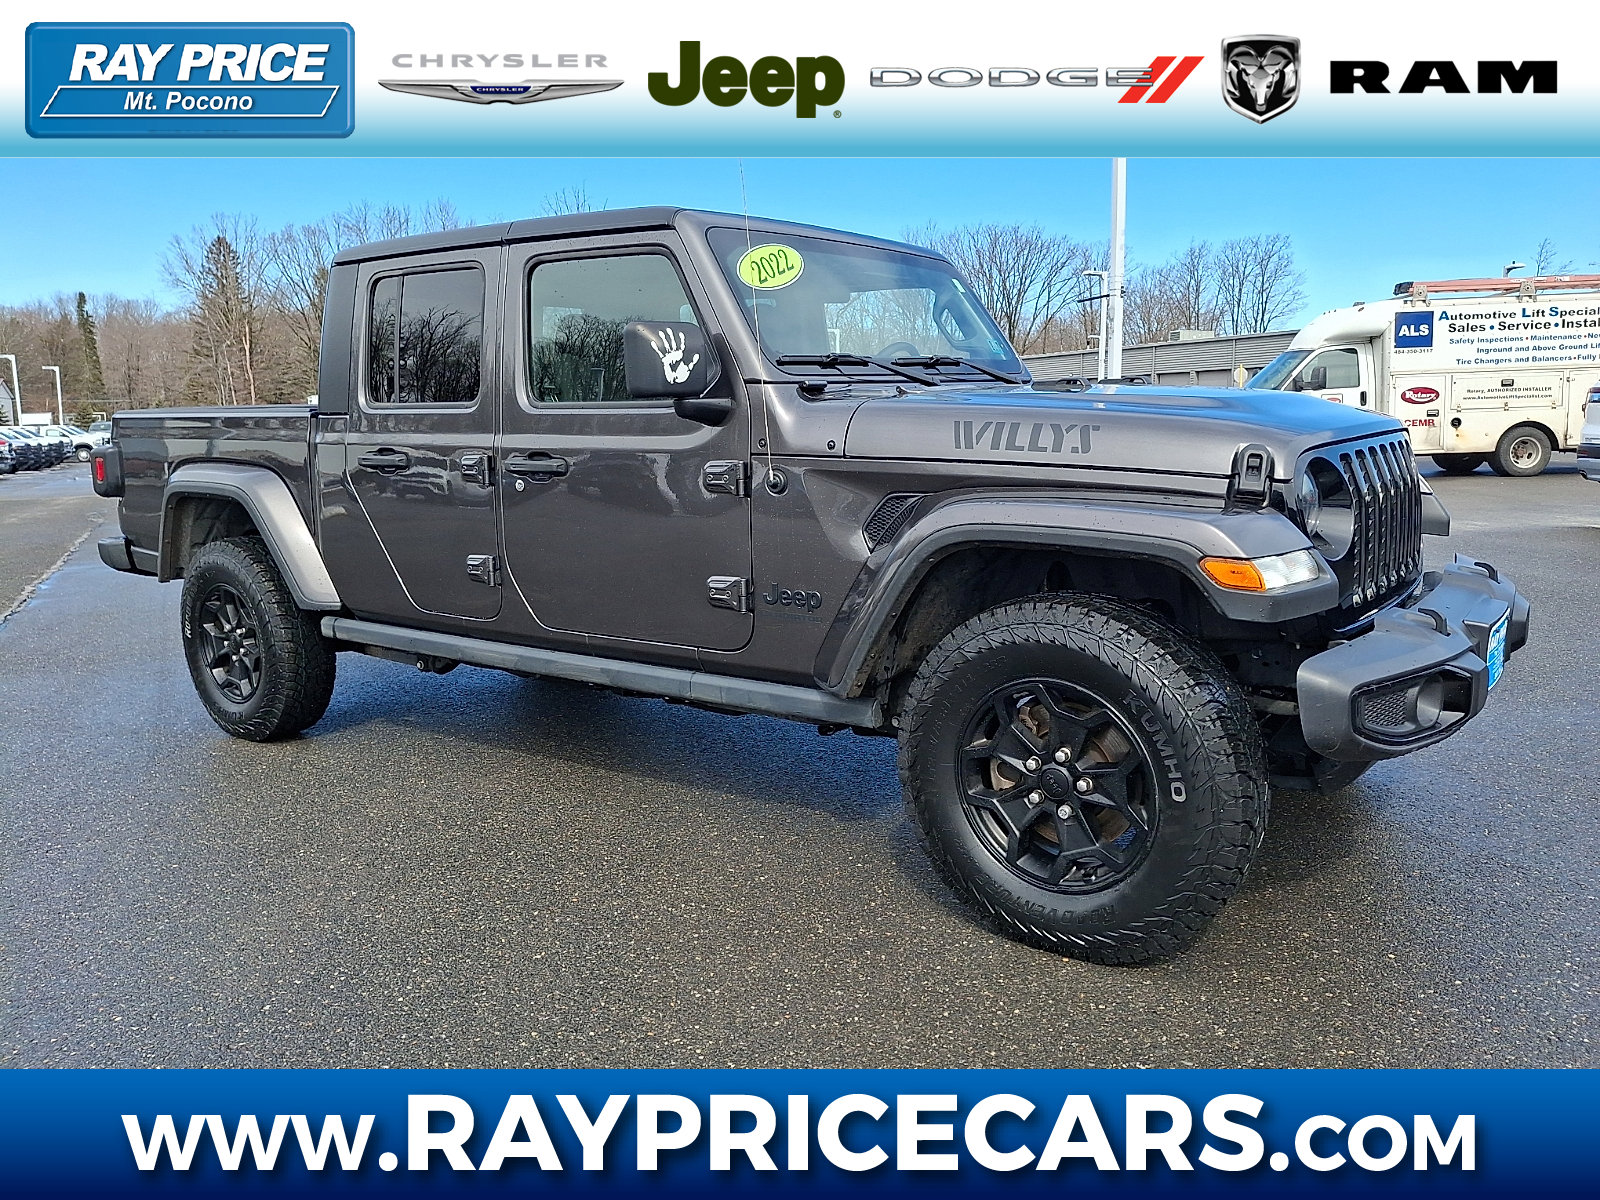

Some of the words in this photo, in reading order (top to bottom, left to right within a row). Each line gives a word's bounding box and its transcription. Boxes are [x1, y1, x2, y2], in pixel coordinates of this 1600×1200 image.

[751, 248, 796, 284] 2022
[1438, 310, 1517, 321] Automotive
[1521, 307, 1546, 318] Lift
[1398, 324, 1430, 337] ALS
[1448, 322, 1486, 333] Sales
[1497, 320, 1552, 331] Service
[1449, 337, 1475, 345] Safety
[1477, 335, 1524, 344] Inspections
[1476, 346, 1513, 355] Inground
[1531, 344, 1557, 352] Above
[1558, 343, 1589, 351] Ground
[1455, 358, 1472, 366] Tire
[1474, 358, 1513, 366] Changers
[1531, 355, 1573, 363] Balancers
[1577, 354, 1597, 362] Fully
[1405, 390, 1437, 400] Rotary
[953, 420, 1101, 454] WILLYS
[762, 582, 823, 613] Jeep
[1123, 689, 1188, 803] KUMHO
